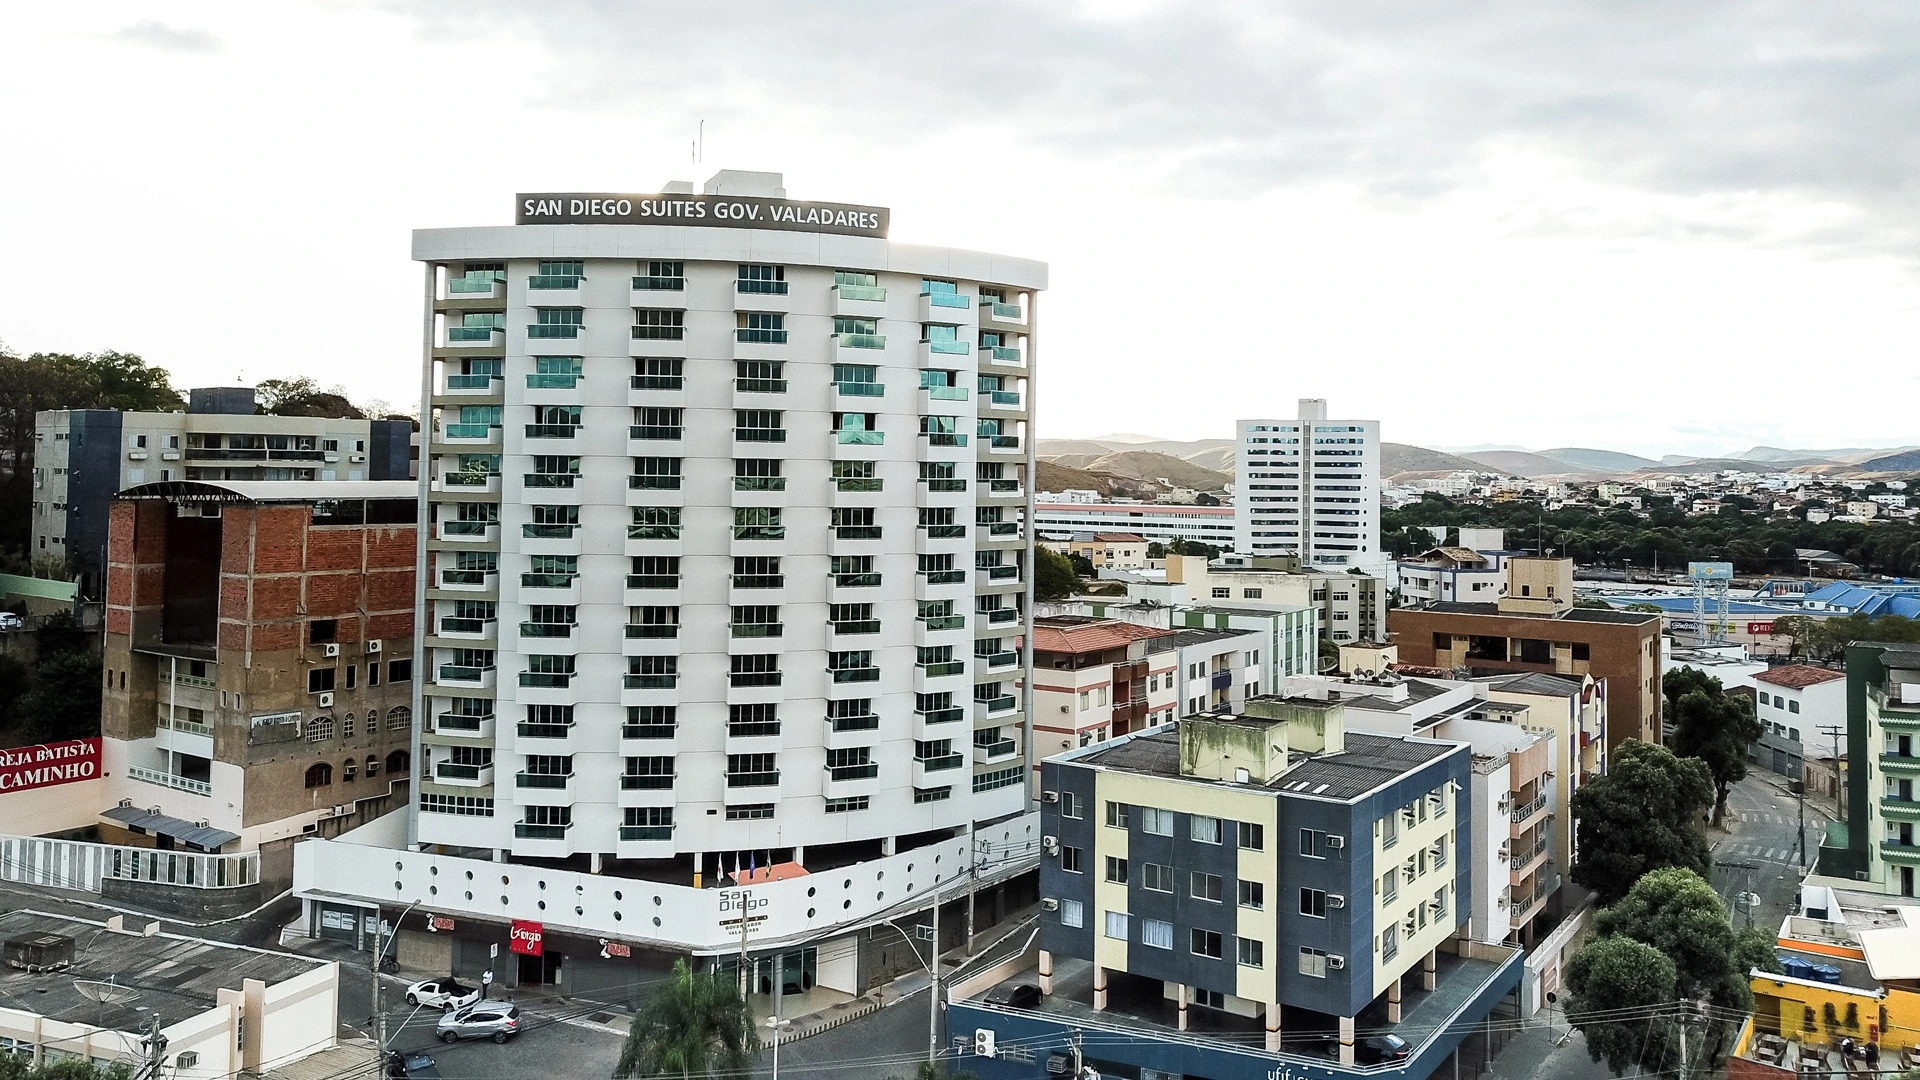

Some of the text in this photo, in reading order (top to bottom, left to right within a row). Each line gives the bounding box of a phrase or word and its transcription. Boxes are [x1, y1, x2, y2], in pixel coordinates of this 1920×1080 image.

[524, 199, 879, 229] SAN DIEGO SUITES GOV. VALADARES
[0, 743, 95, 767] REJA BATISTA
[0, 761, 95, 789] CAMINHO
[719, 898, 768, 911] Diego
[720, 890, 751, 901] San
[510, 925, 542, 950] Giorgio
